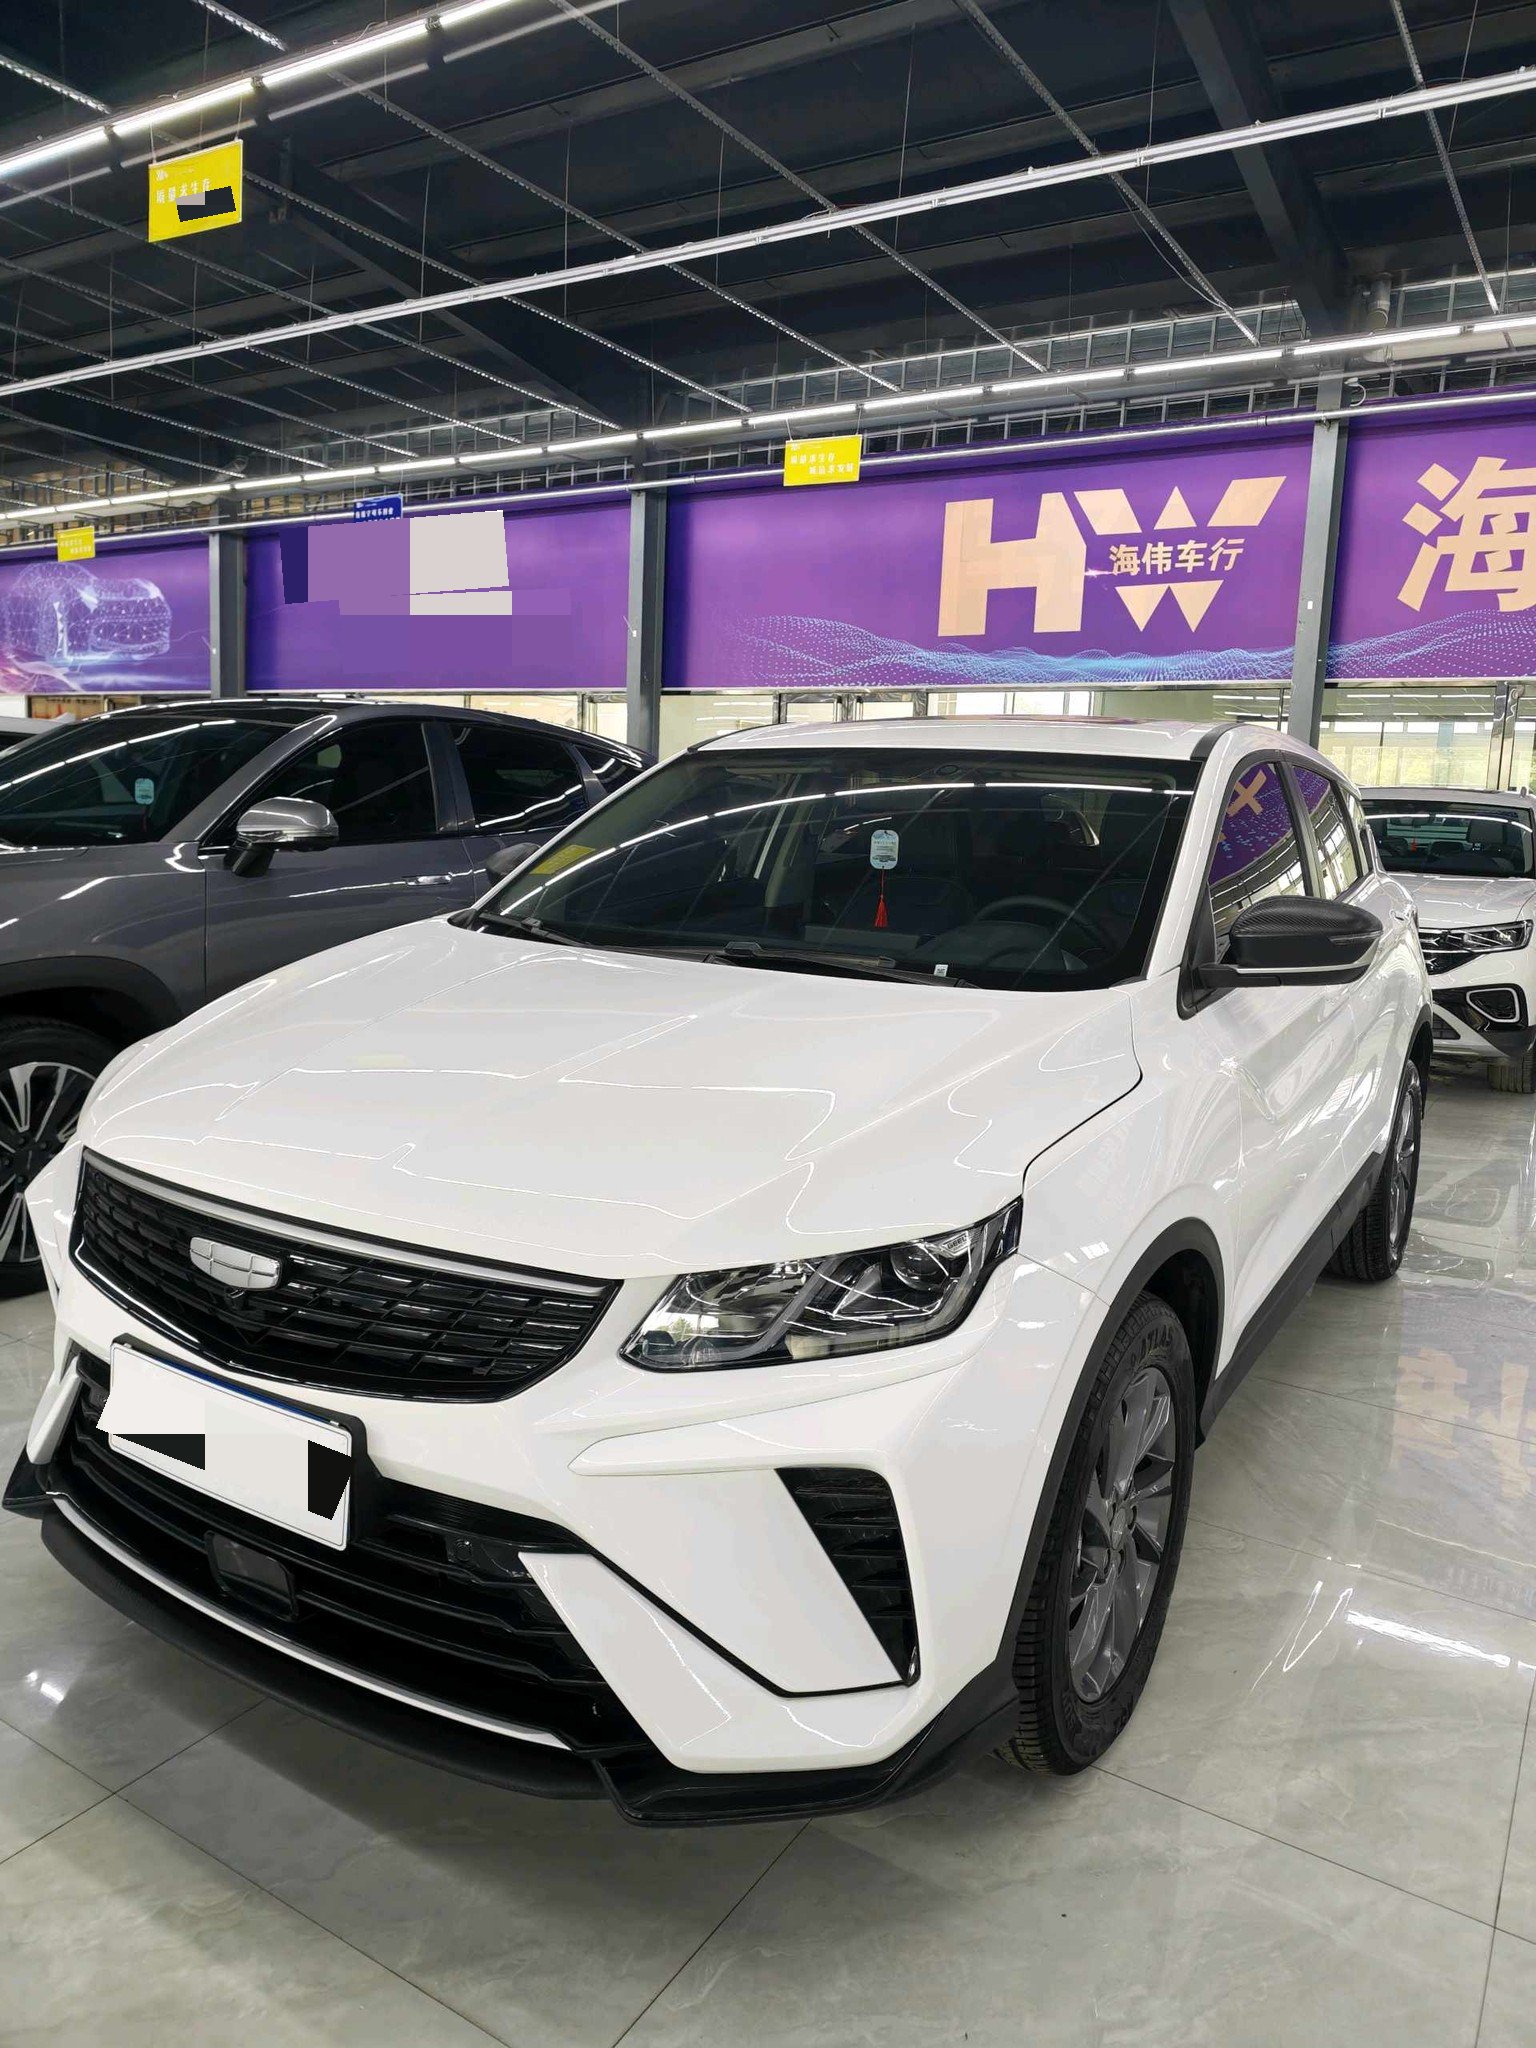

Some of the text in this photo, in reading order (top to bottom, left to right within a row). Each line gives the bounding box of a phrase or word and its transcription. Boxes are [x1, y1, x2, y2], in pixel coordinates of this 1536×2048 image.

[938, 476, 1287, 637] HW
[1109, 537, 1246, 576] 海伟车行
[1397, 456, 1536, 612] 海
